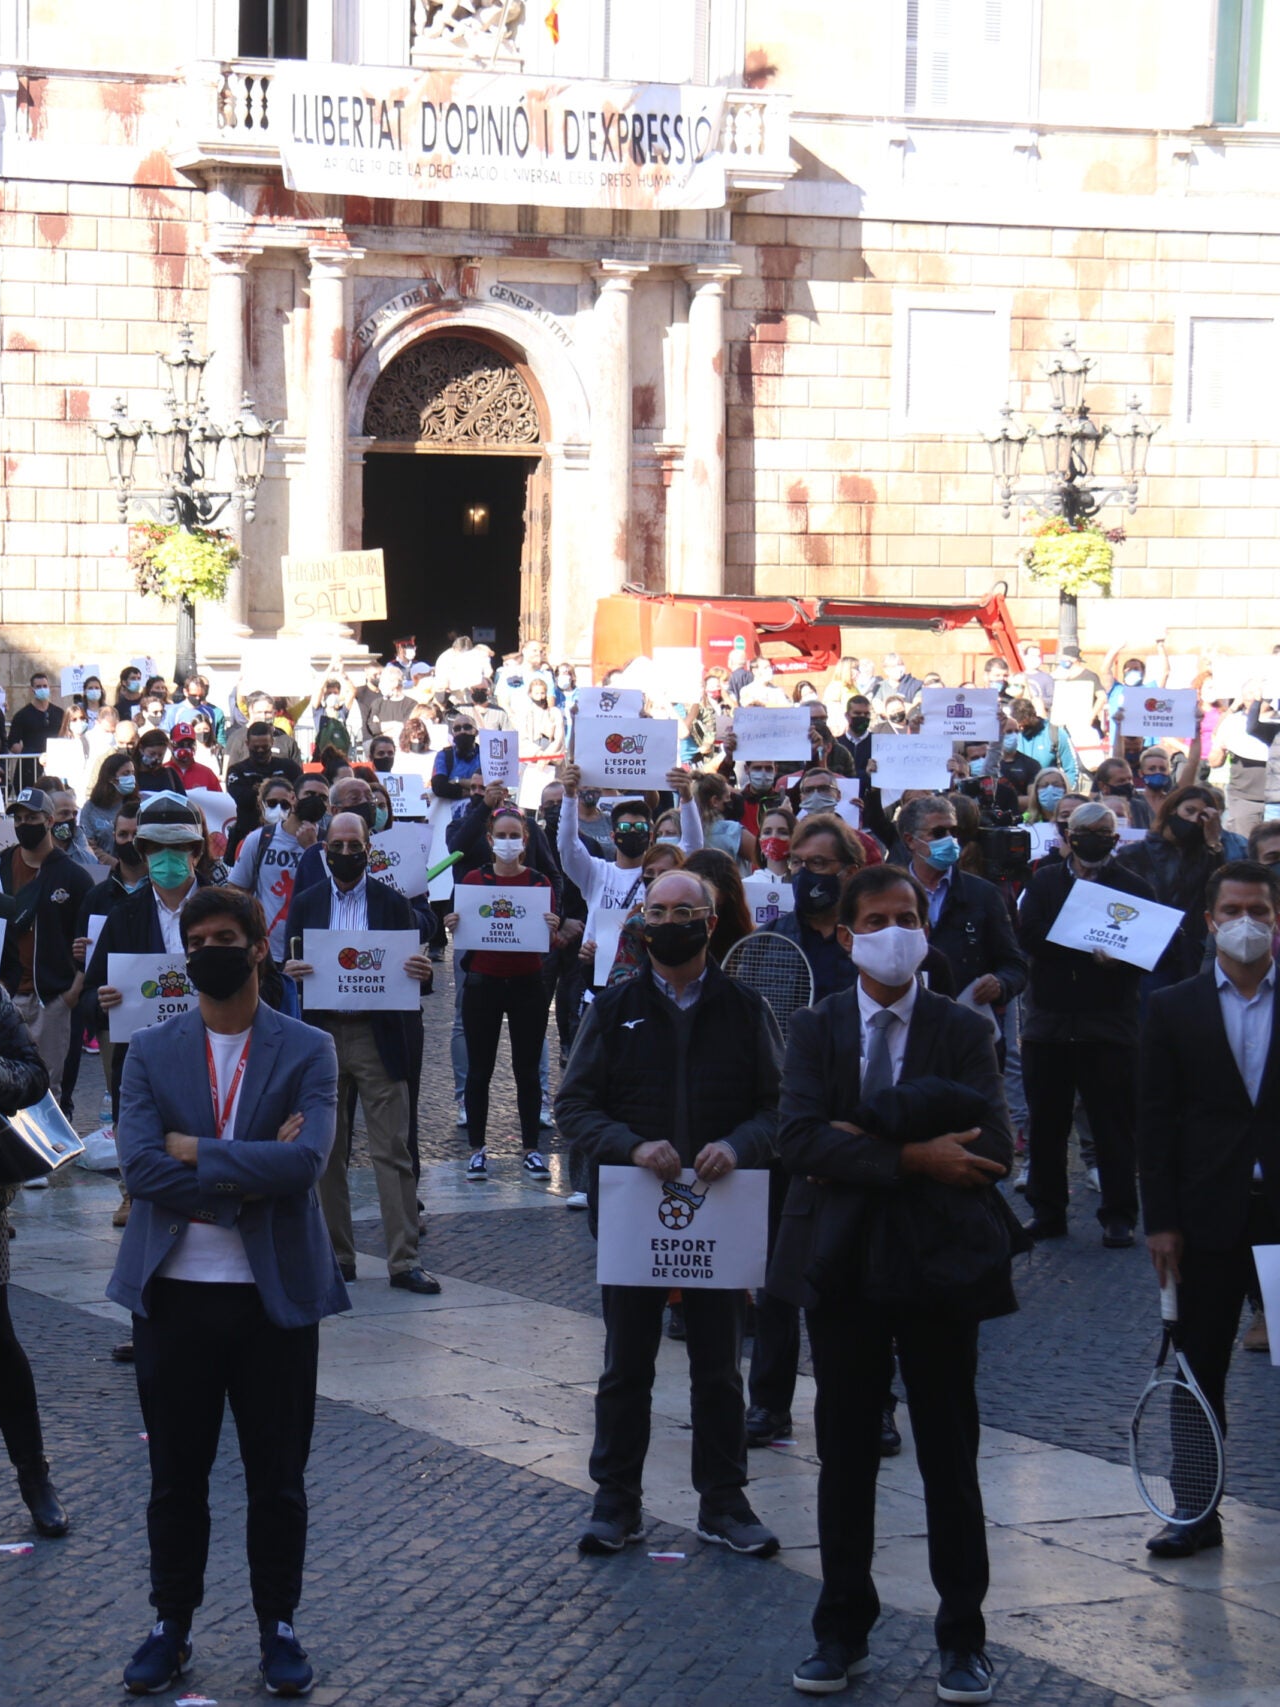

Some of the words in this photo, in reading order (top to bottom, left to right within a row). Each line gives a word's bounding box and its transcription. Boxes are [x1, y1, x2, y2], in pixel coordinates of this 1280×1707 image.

[292, 93, 405, 151] LLIBERTAT
[421, 95, 530, 159] D'OPINIÓ
[543, 108, 550, 159] I
[563, 105, 712, 168] D'EXPRESSIÓ
[294, 585, 383, 620] SALUT
[604, 766, 614, 774] ÉS
[491, 922, 513, 930] SOM
[1083, 934, 1127, 949] COMPETIR
[1090, 928, 1128, 942] VOLEM
[158, 1003, 188, 1014] SOM
[651, 1238, 716, 1252] ESPORT
[655, 1253, 712, 1267] LLIURE
[652, 1267, 668, 1277] DE
[672, 1268, 714, 1279] COVID
